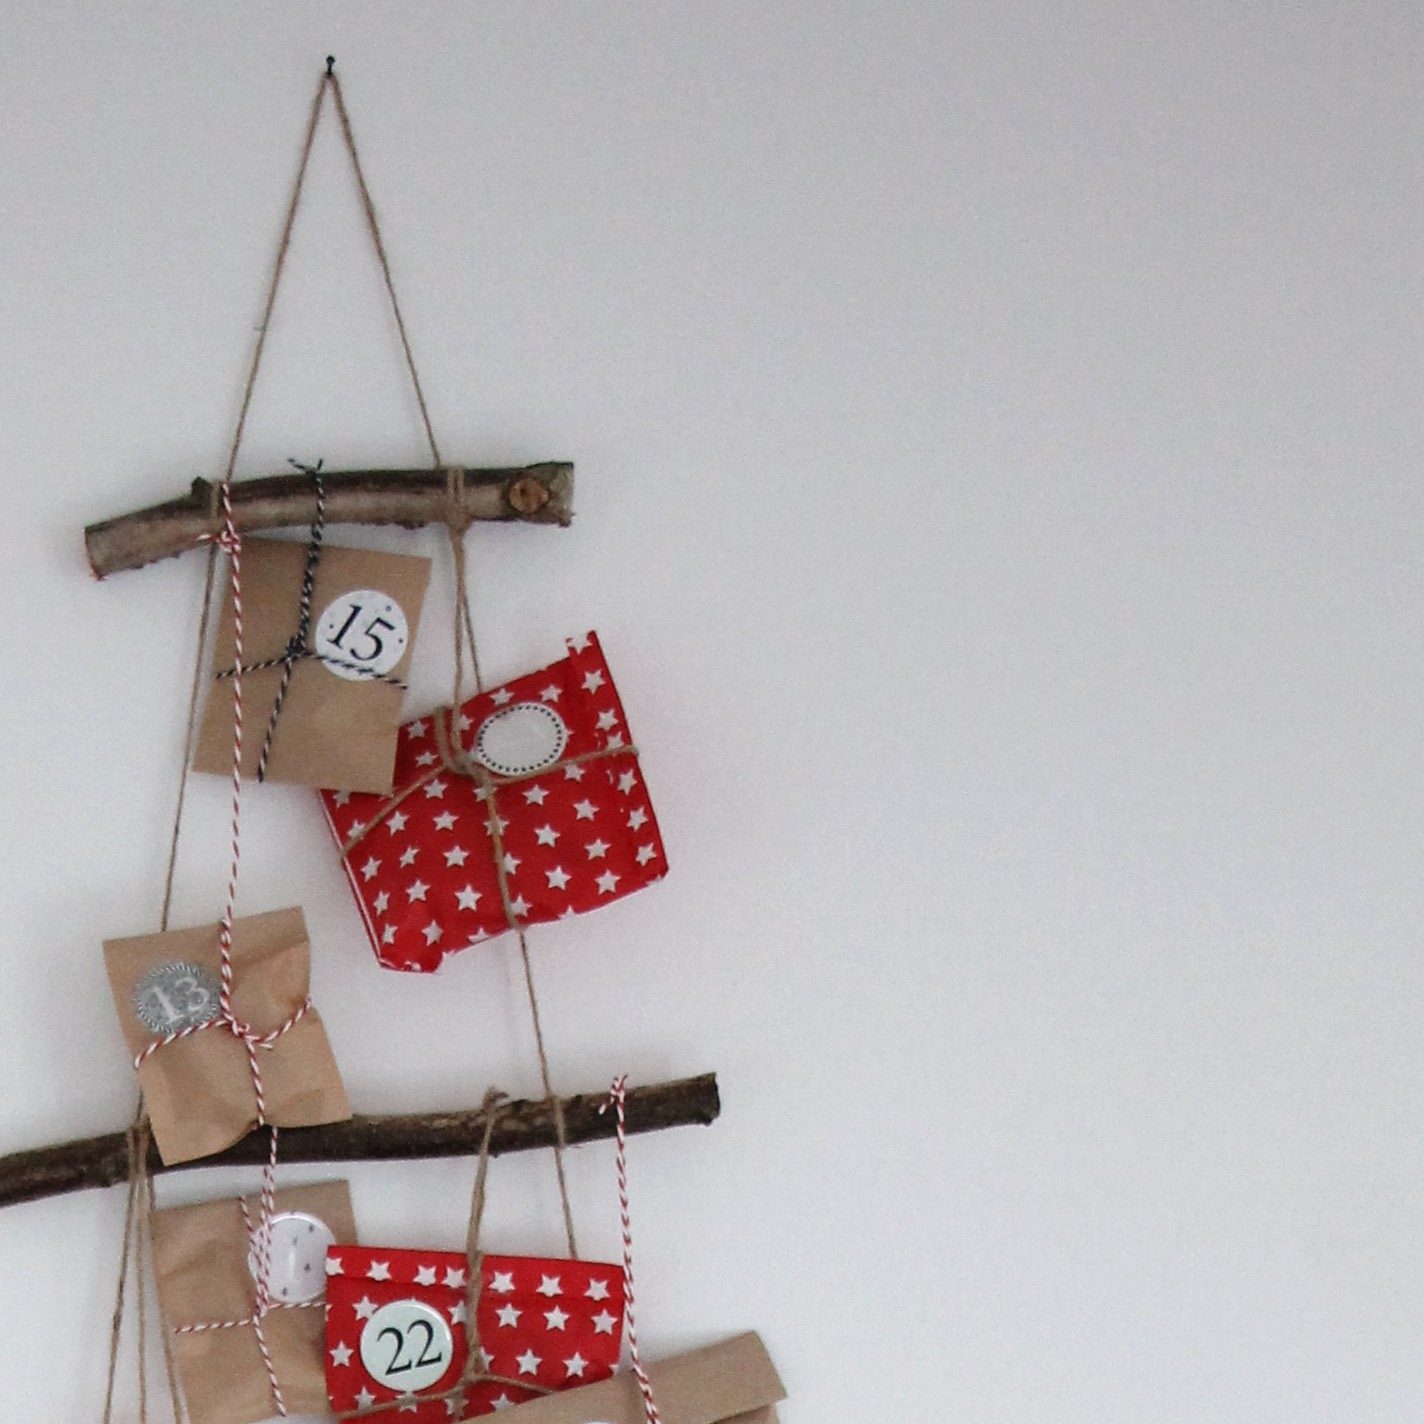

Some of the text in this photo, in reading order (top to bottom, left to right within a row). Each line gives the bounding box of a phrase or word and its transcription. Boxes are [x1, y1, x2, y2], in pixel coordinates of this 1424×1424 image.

[327, 603, 393, 660] 15
[152, 978, 210, 1024] 13
[378, 1321, 442, 1378] 22
